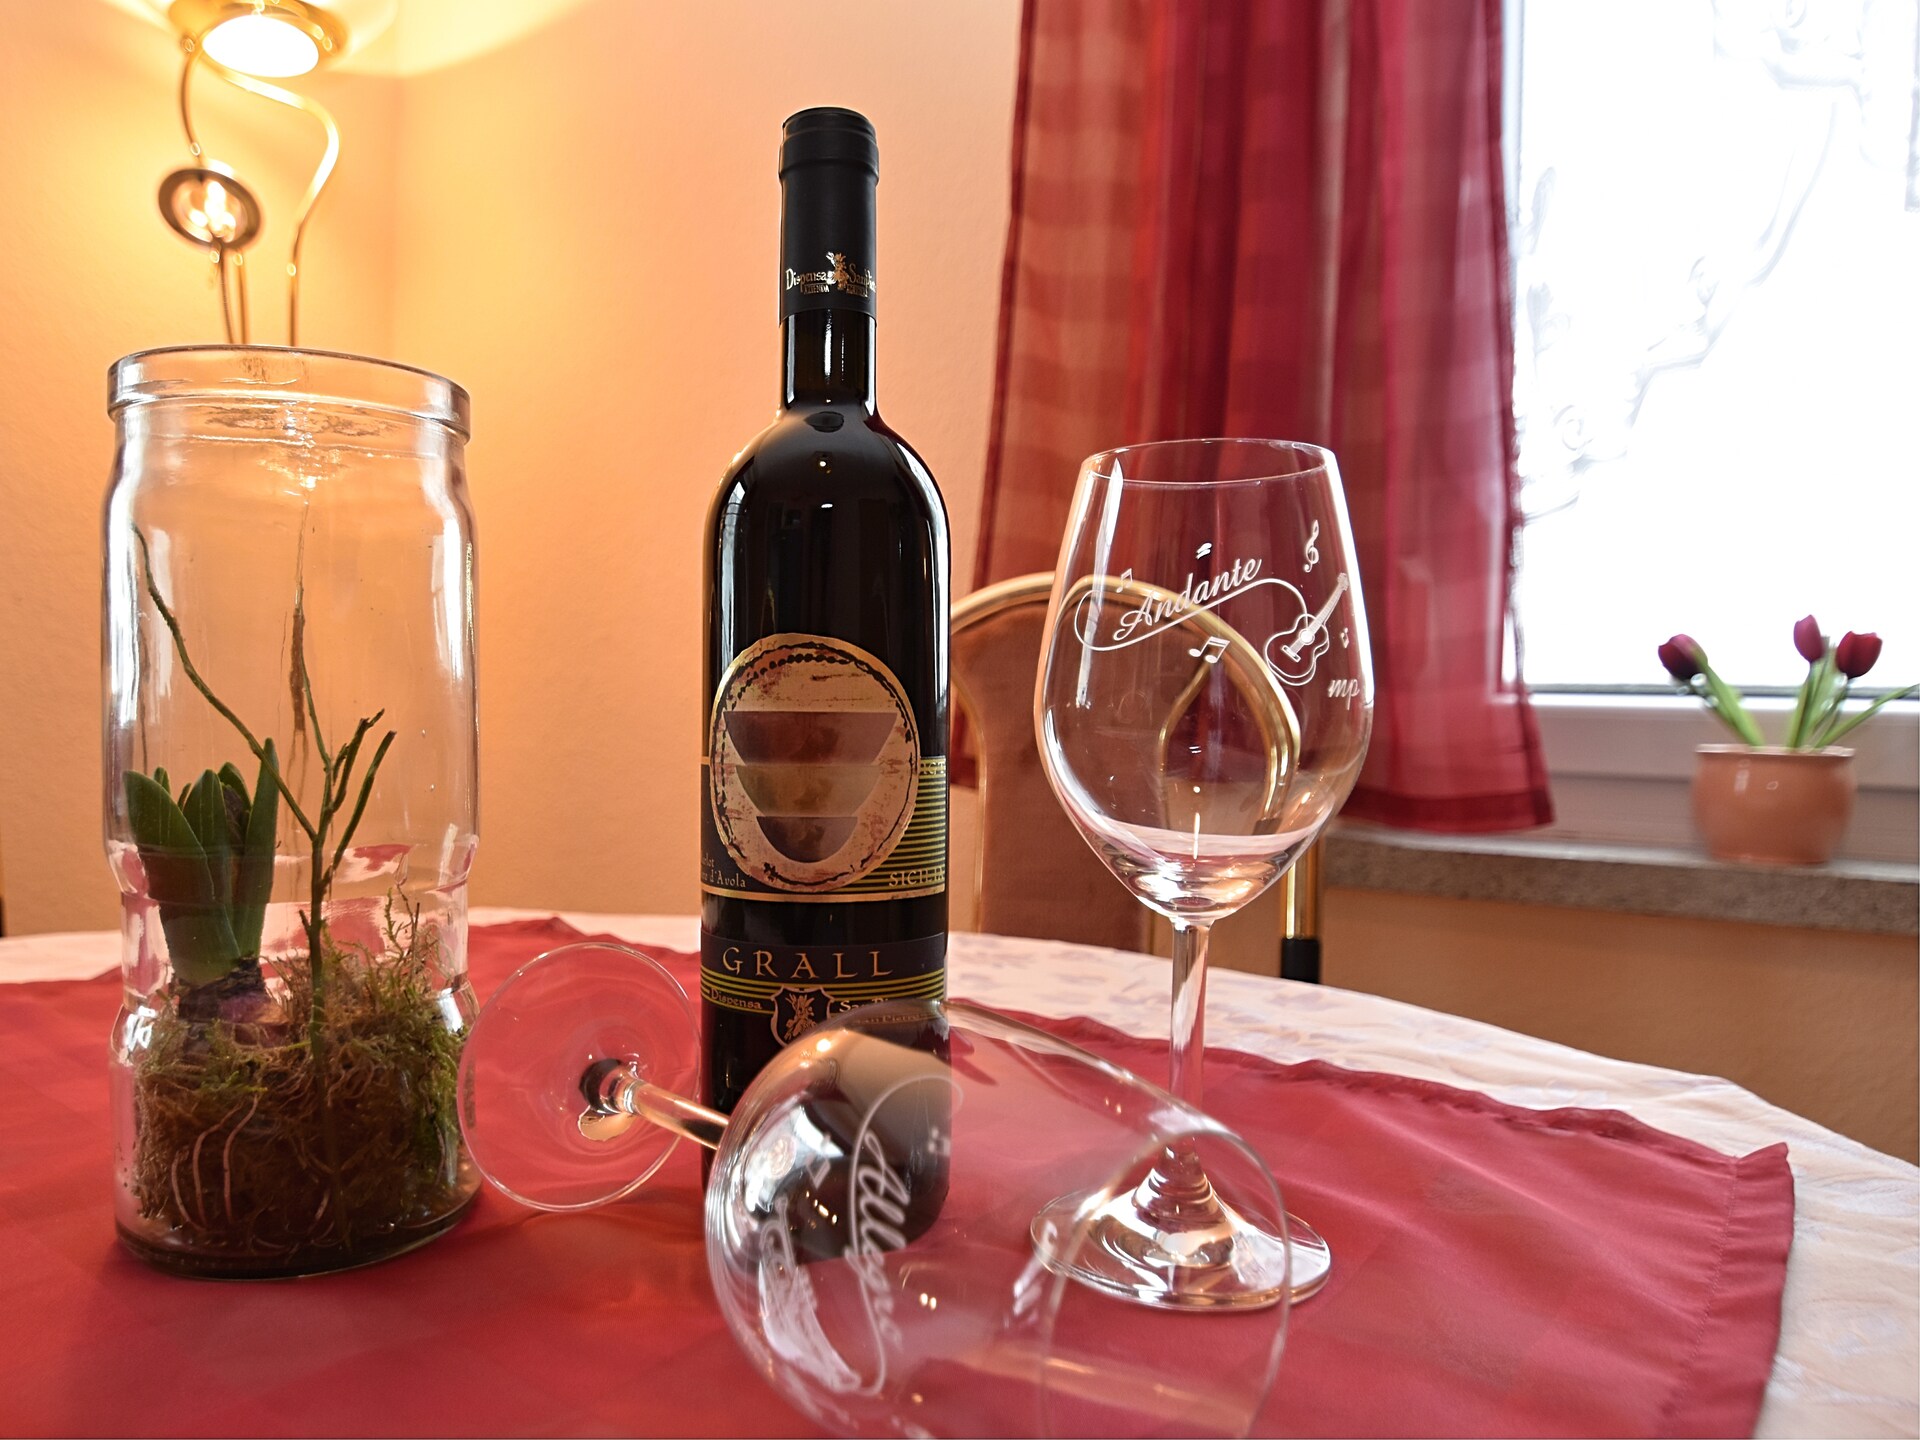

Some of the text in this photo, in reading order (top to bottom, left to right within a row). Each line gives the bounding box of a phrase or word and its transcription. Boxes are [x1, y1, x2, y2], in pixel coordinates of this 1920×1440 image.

[1112, 557, 1262, 641] Andante
[888, 866, 946, 887] SICILIA
[722, 947, 893, 978] GRALL
[710, 988, 762, 1010] Dispensa
